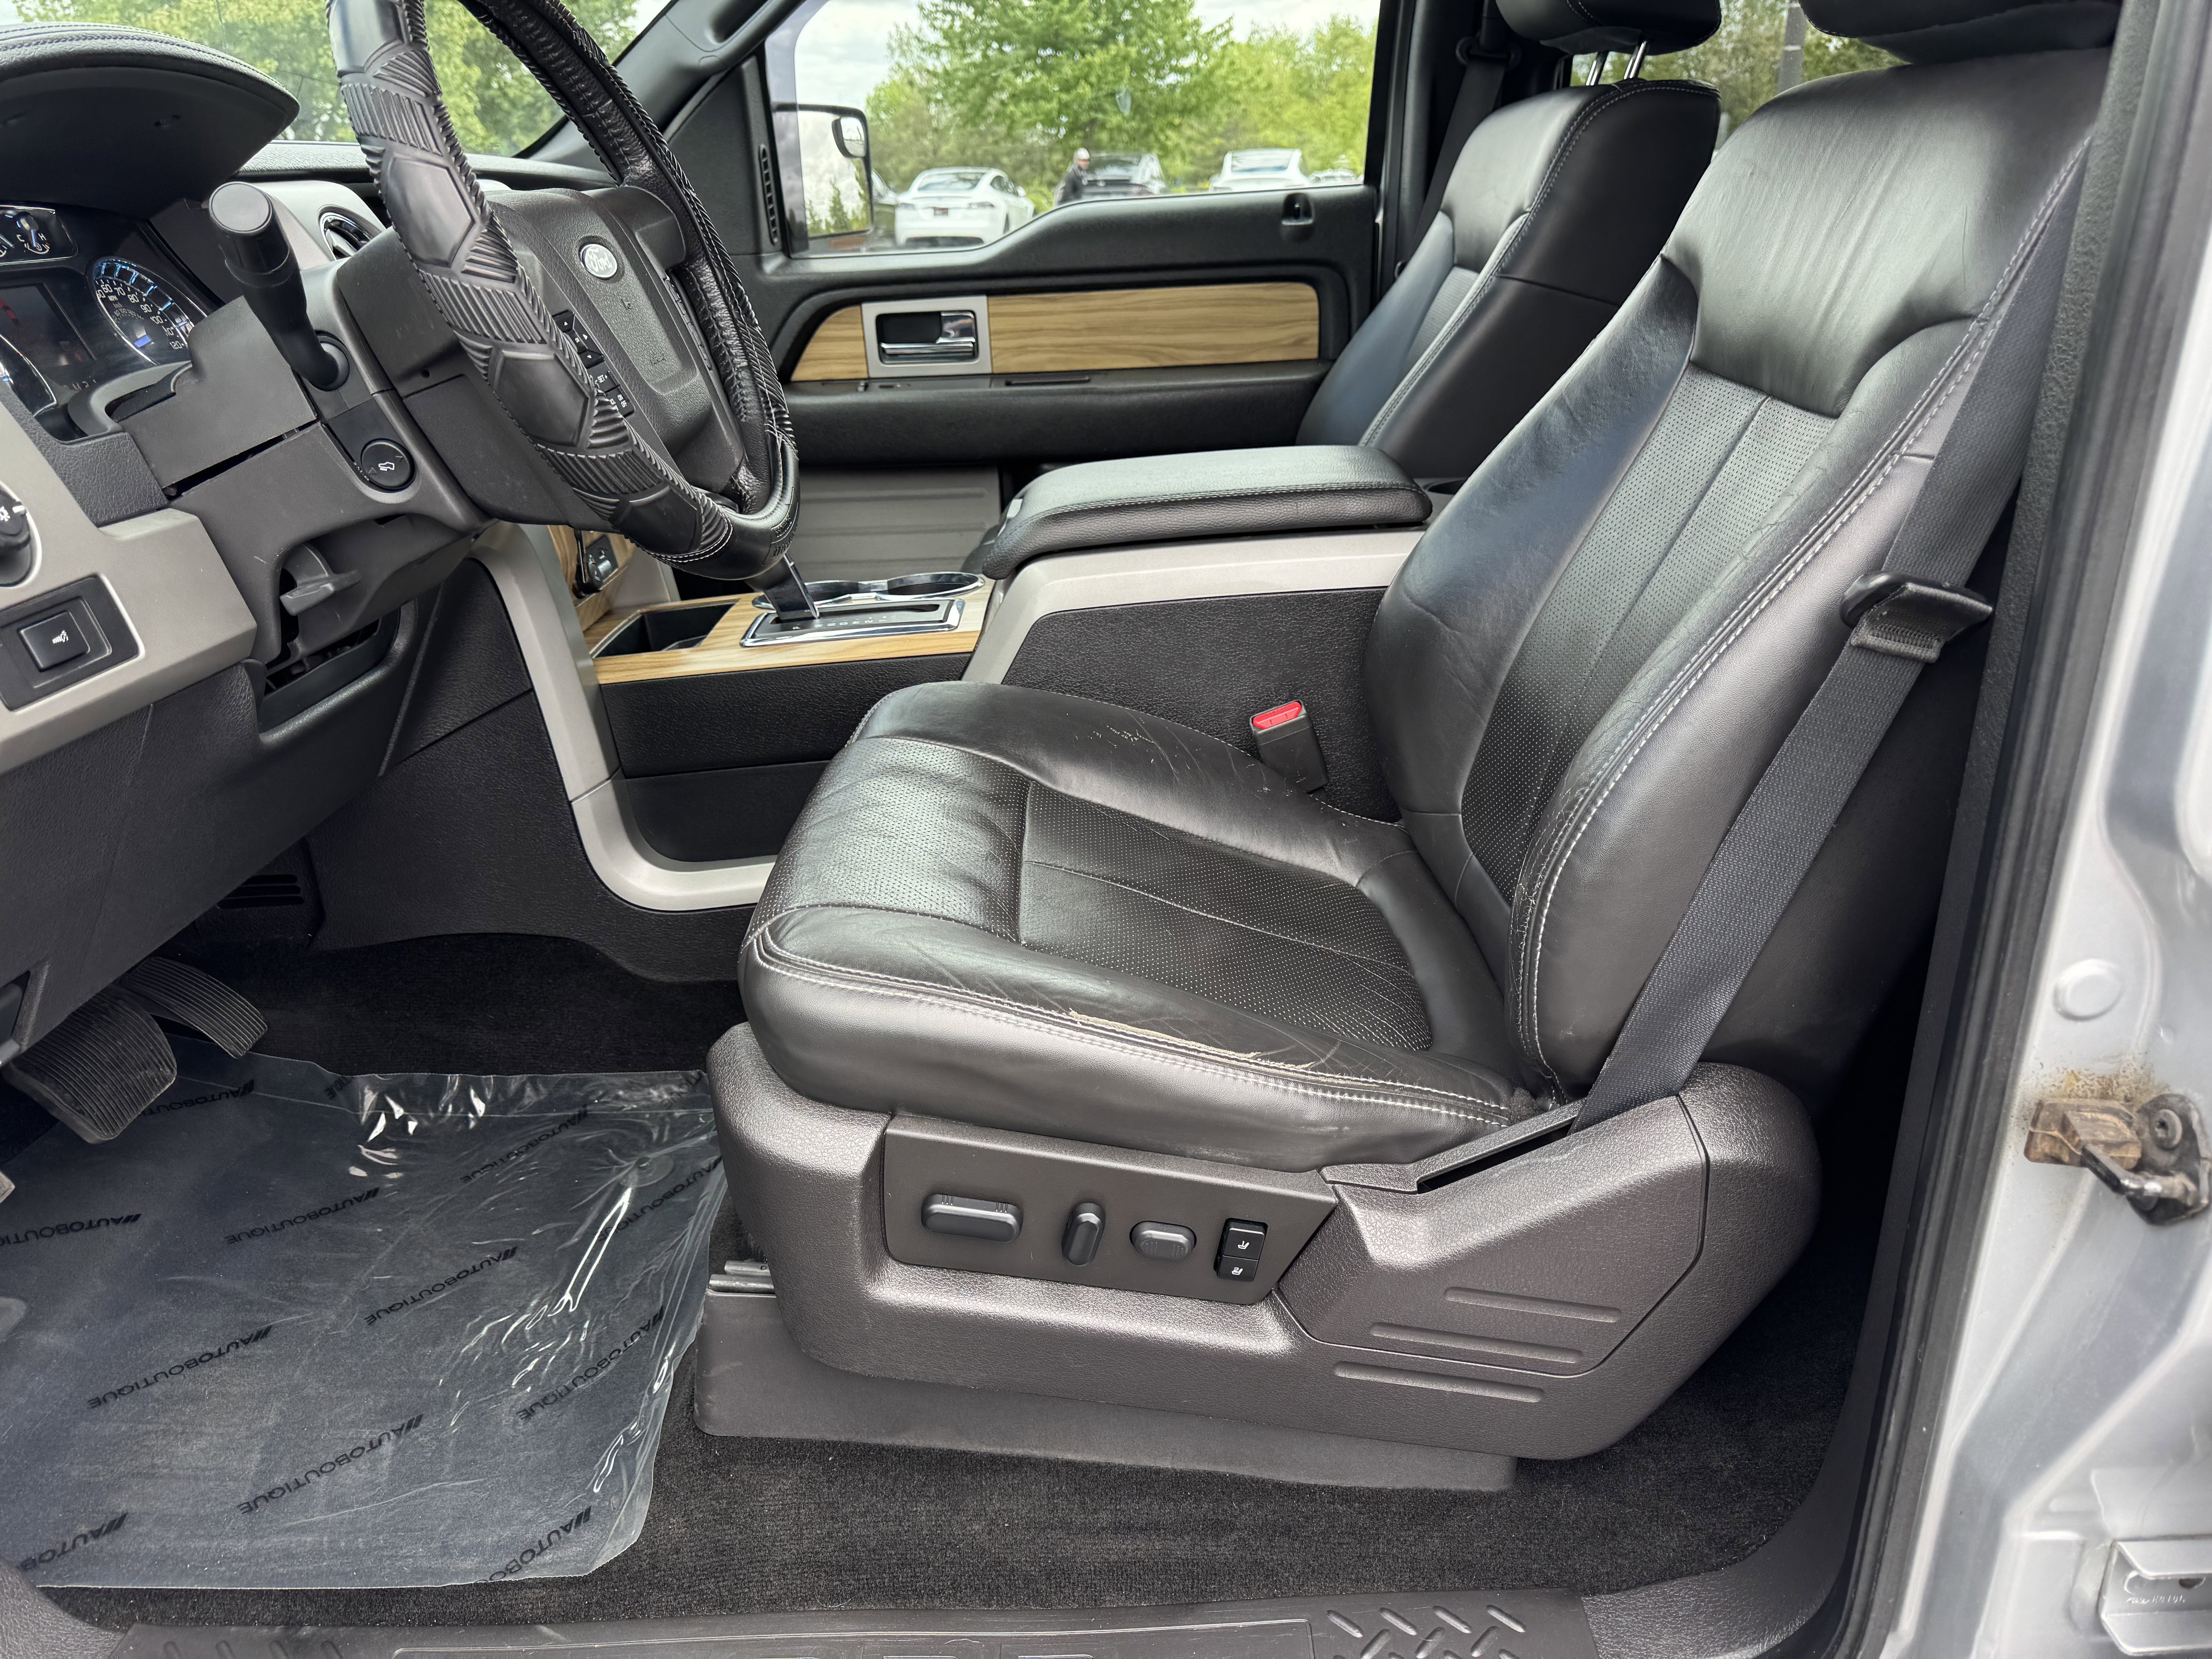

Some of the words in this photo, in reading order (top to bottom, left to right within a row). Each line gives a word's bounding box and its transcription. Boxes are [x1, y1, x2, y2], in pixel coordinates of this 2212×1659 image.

[586, 247, 613, 272] Ford
[101, 284, 113, 293] 60
[114, 287, 126, 296] 70
[127, 294, 139, 303] 80
[140, 304, 152, 313] 90
[169, 341, 183, 350] 120
[141, 1087, 241, 1116] AUTOBOUT
[225, 1193, 365, 1244] AUTOBOUTIQUE
[364, 1252, 502, 1326] AUTOBOUTIQUE
[87, 1333, 254, 1409] AUTOBOUTIQUE
[237, 1423, 405, 1515] AUTOBOUTIQUE
